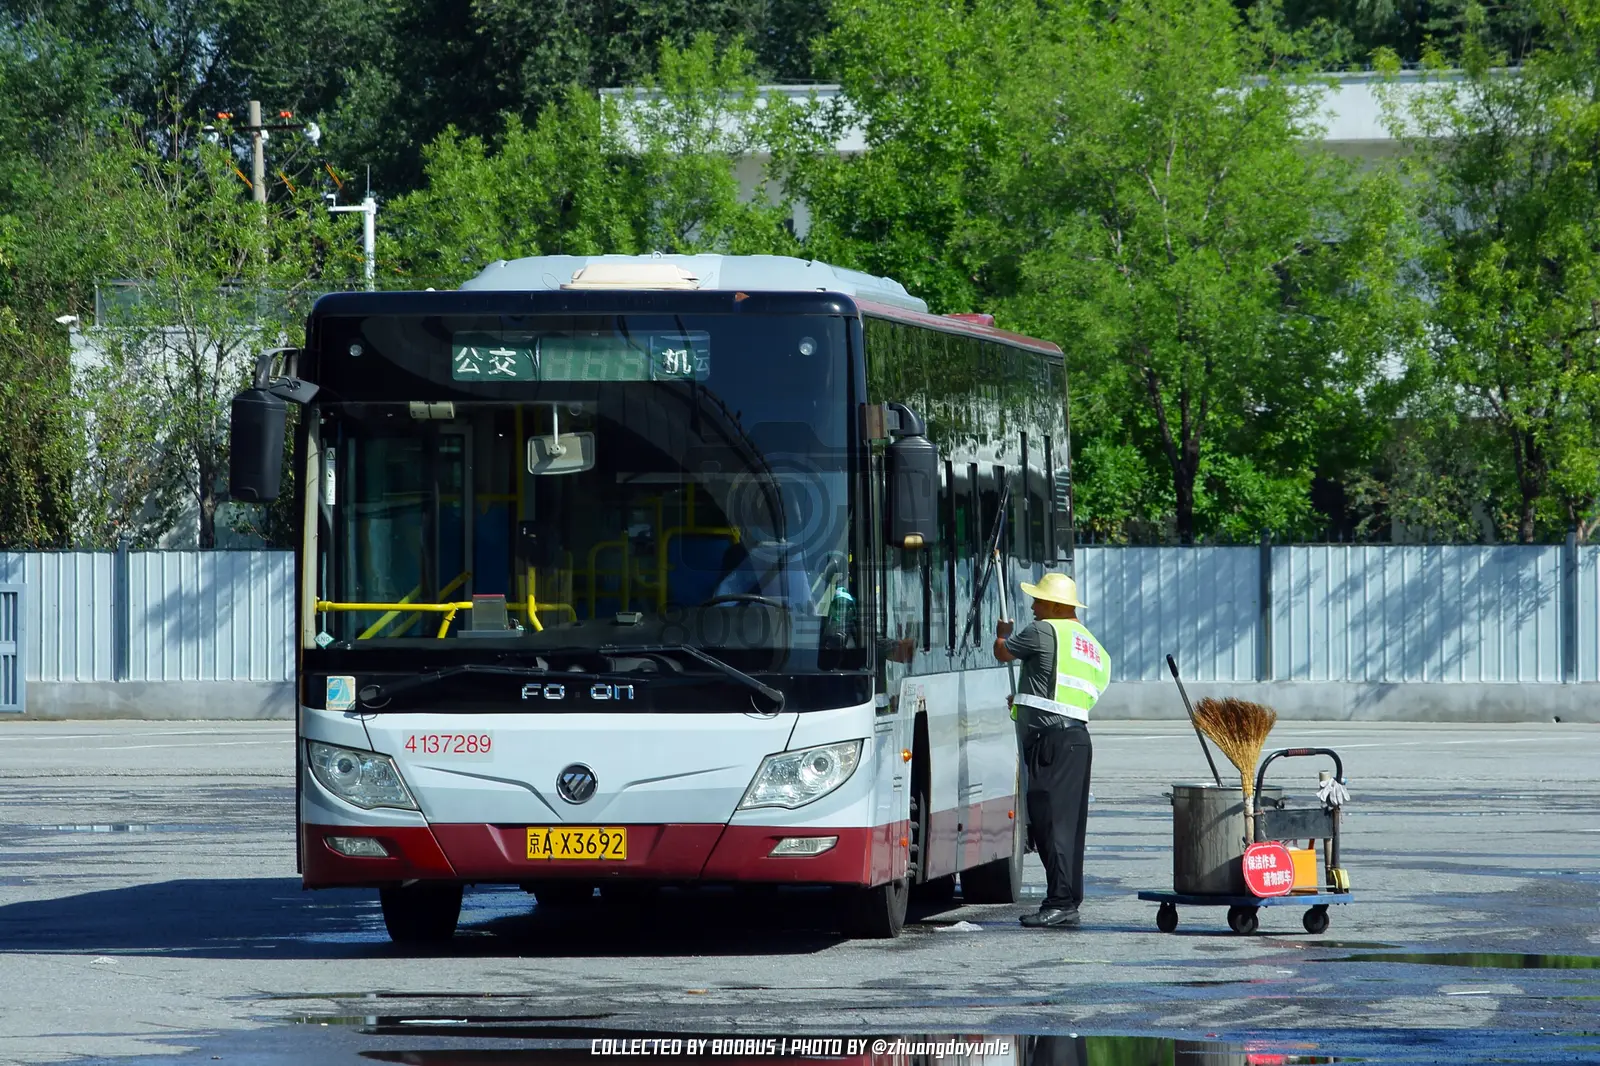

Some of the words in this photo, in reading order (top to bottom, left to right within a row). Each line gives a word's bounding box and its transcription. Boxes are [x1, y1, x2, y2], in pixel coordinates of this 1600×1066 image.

[455, 347, 517, 376] 公交
[404, 734, 492, 754] 4137289
[1247, 853, 1278, 871] 保洁作业
